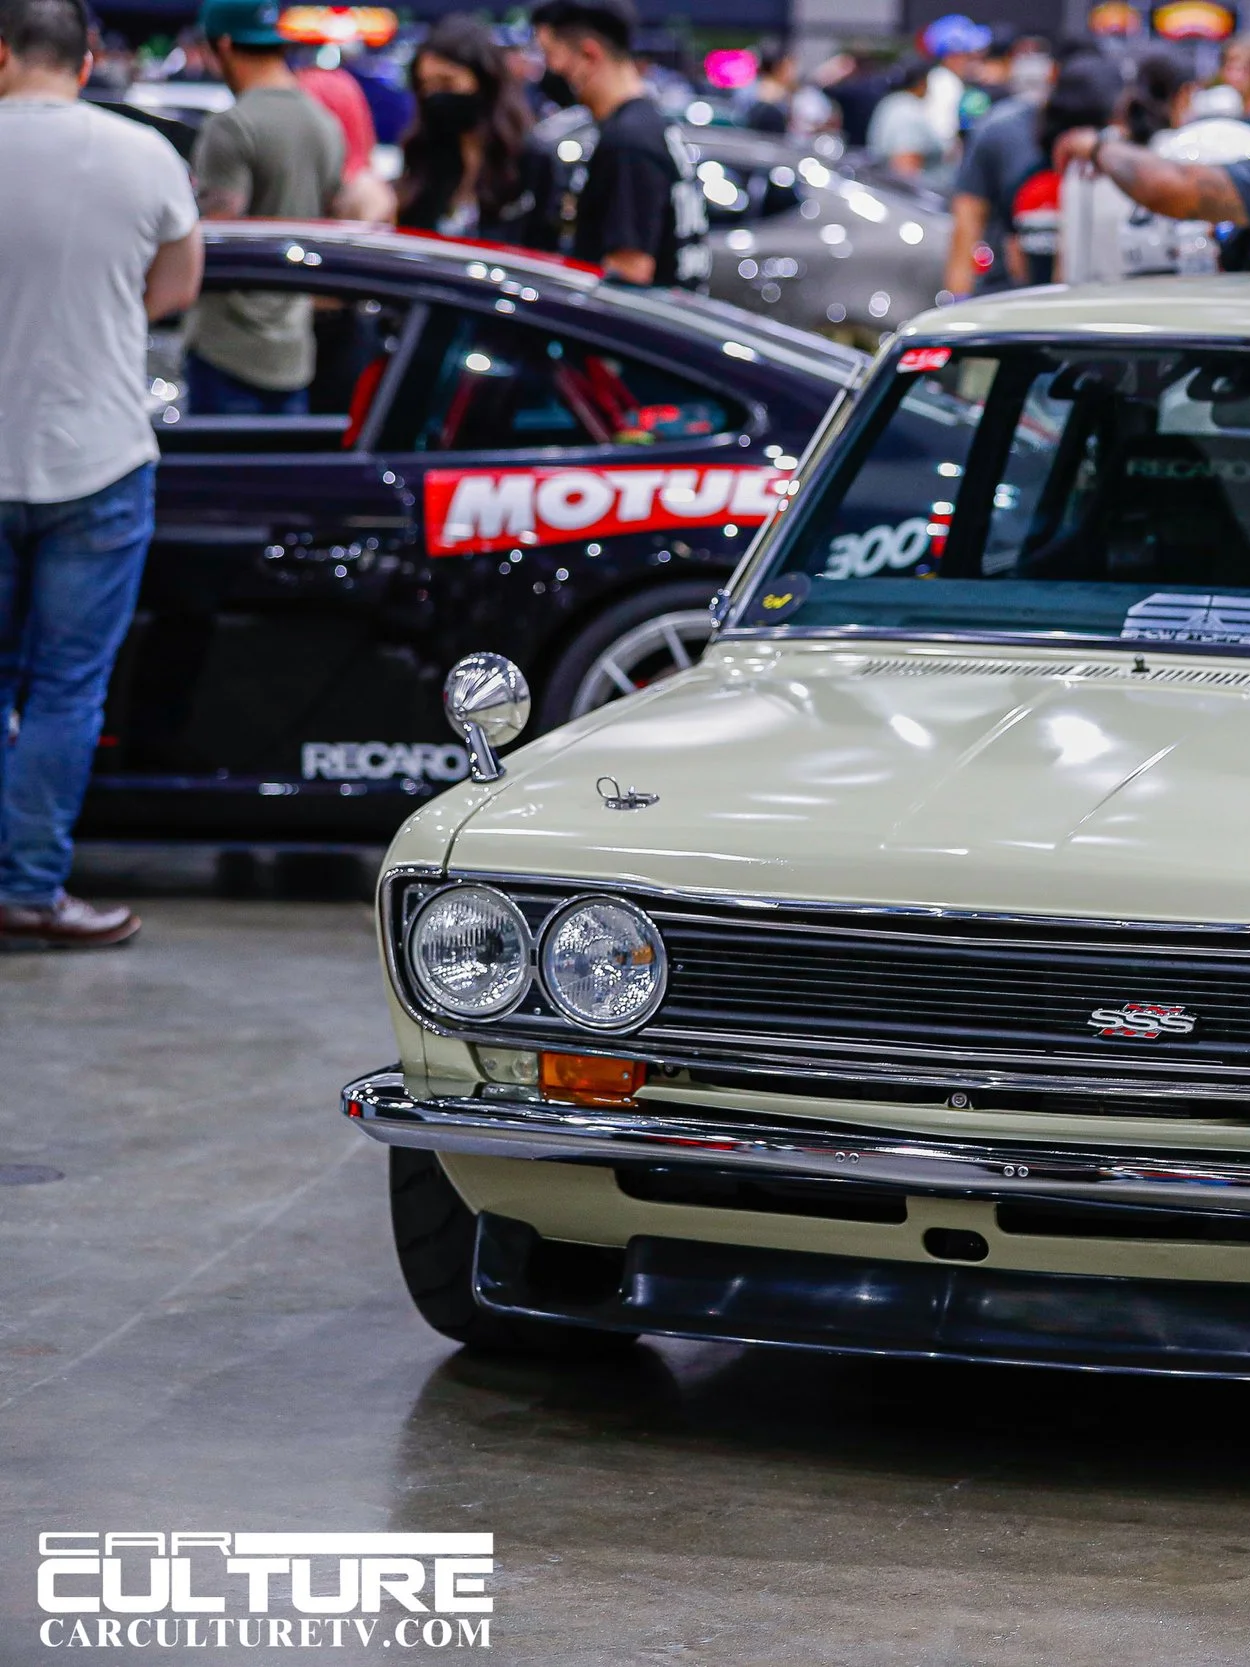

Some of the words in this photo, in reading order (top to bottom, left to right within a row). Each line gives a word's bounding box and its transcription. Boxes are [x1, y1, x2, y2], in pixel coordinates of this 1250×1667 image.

[441, 470, 782, 546] MOTUL
[301, 740, 472, 782] RECARO
[1086, 1008, 1198, 1034] SSS
